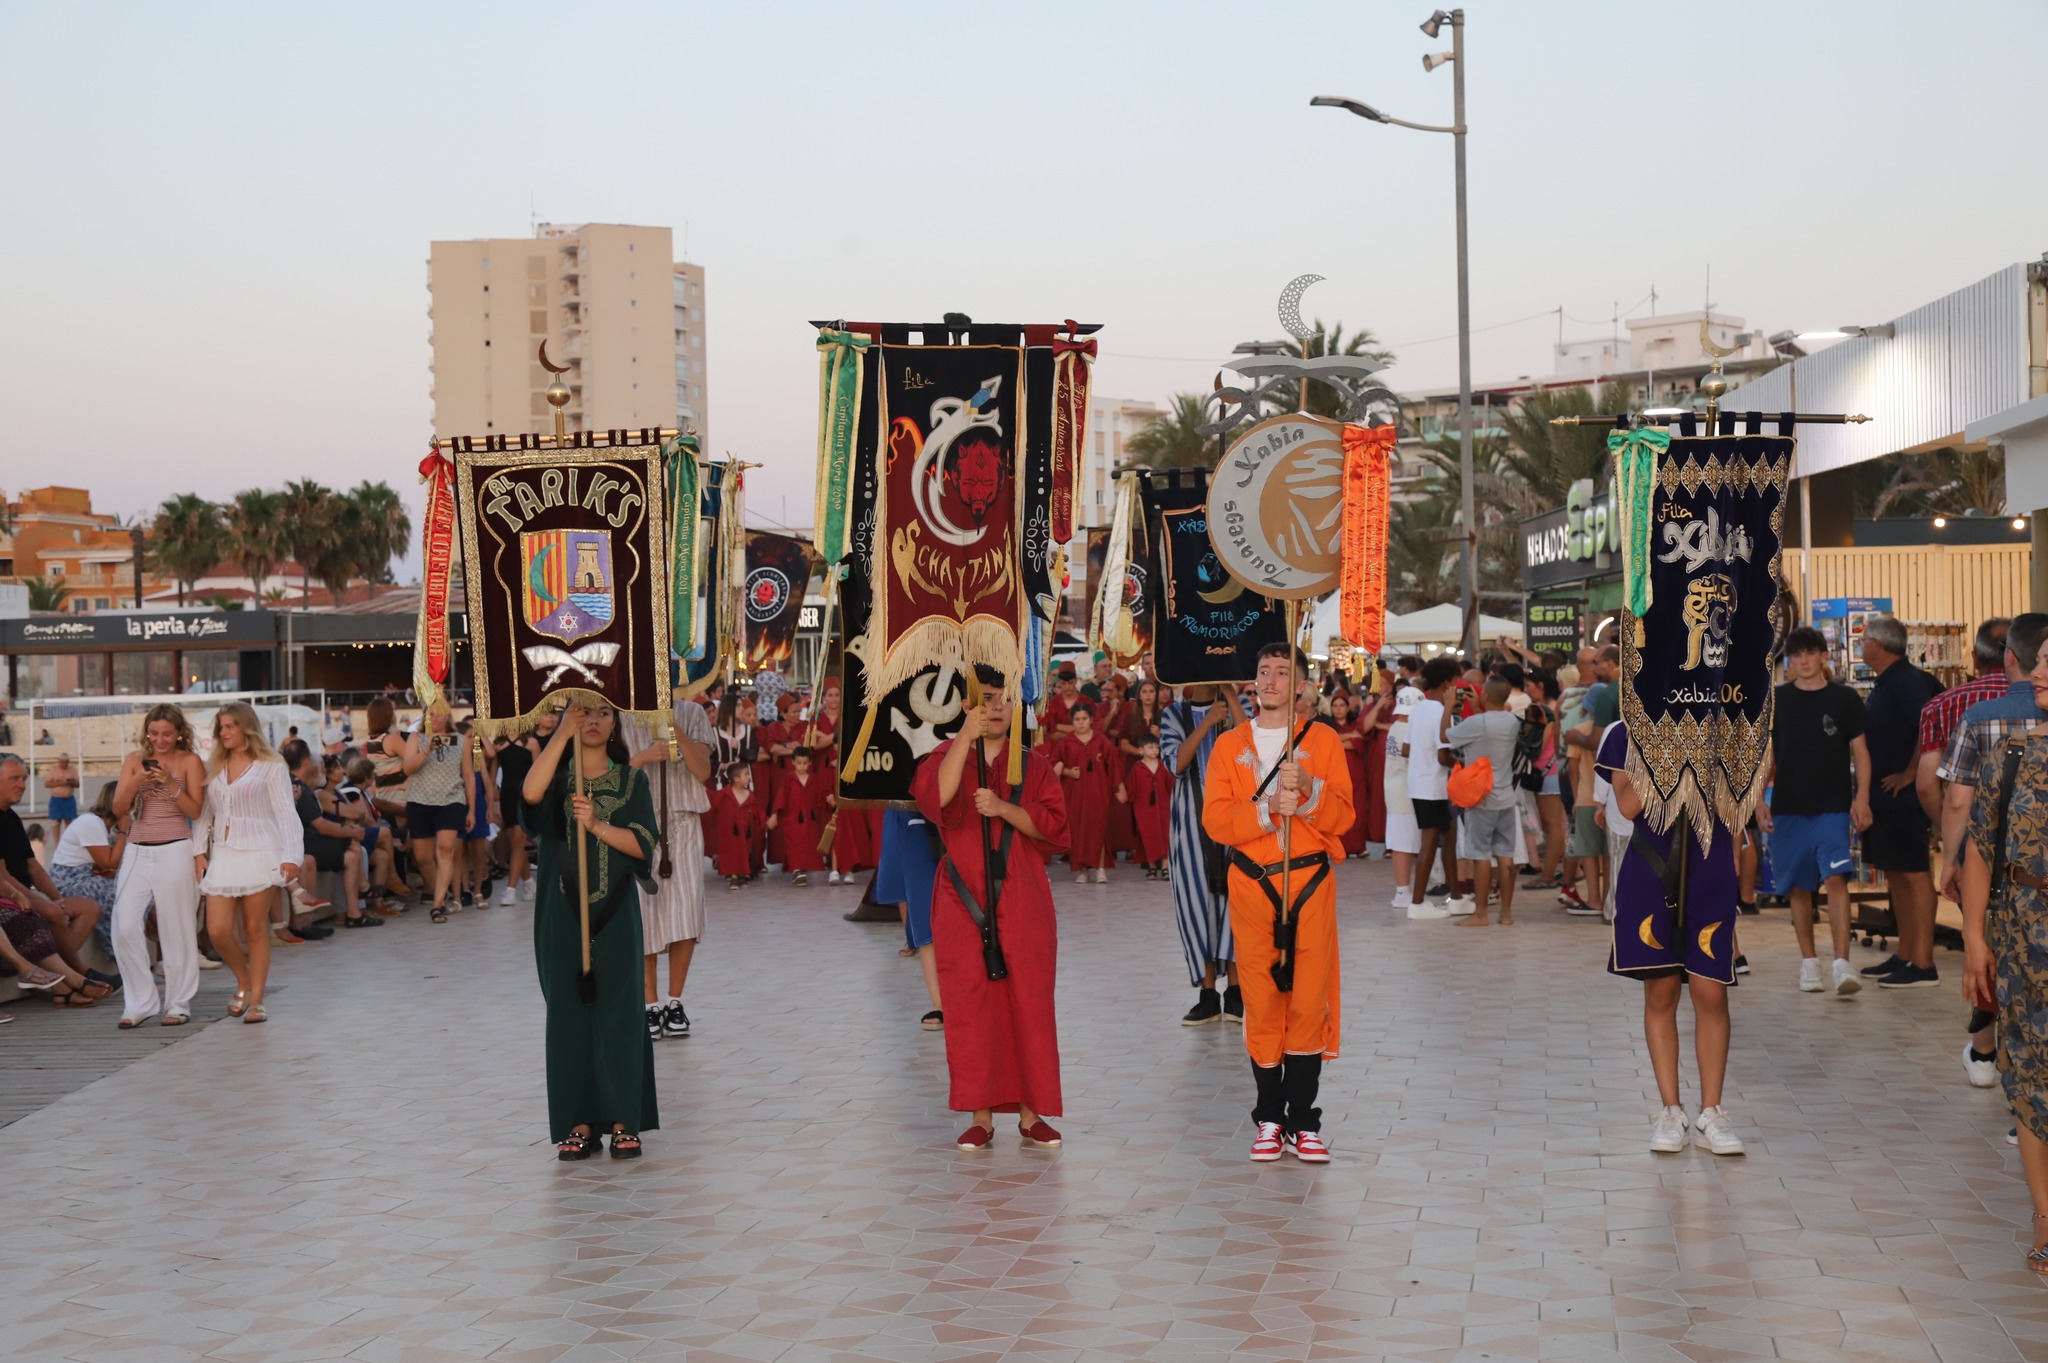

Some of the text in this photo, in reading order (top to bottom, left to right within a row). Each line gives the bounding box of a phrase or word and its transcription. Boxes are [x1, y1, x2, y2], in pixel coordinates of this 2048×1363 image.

[488, 475, 516, 498] AL
[486, 468, 642, 533] TARIK'S
[1177, 519, 1207, 534] XÀB
[679, 543, 692, 571] Mora
[1527, 523, 1569, 567] HELADOS
[678, 575, 689, 595] 2011
[126, 617, 141, 636] la
[143, 616, 186, 640] perla
[1179, 610, 1260, 640] ALMORISCOS
[1531, 626, 1574, 636] REFRESCOS
